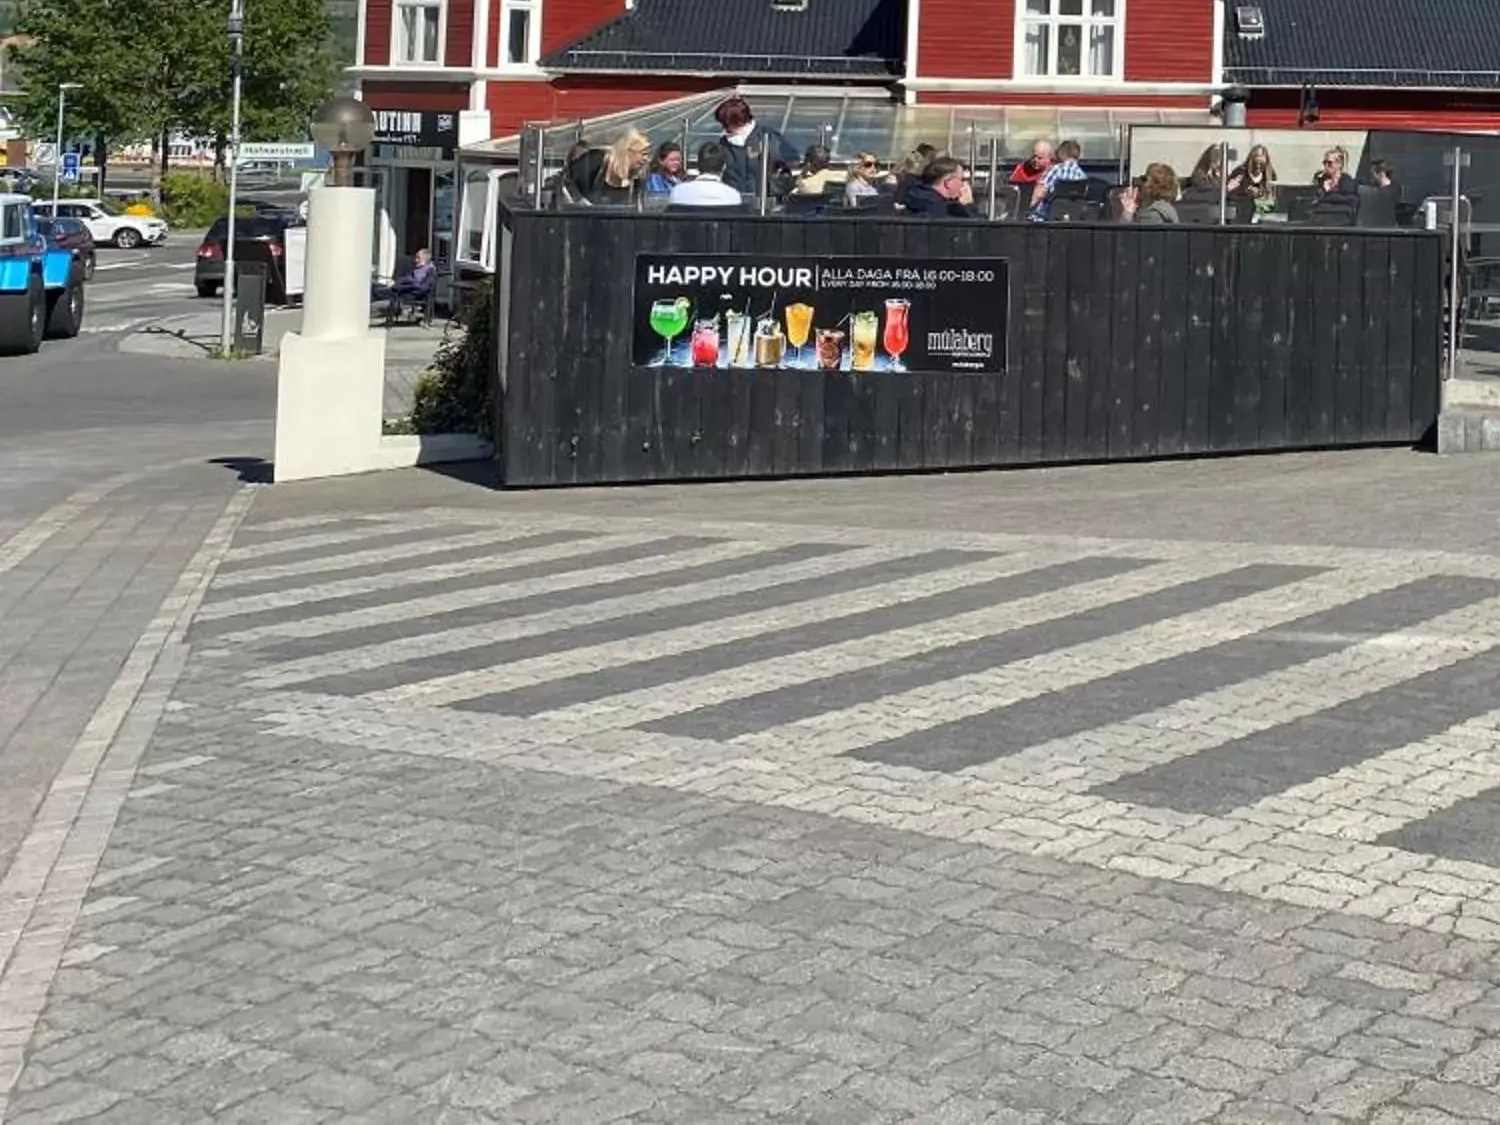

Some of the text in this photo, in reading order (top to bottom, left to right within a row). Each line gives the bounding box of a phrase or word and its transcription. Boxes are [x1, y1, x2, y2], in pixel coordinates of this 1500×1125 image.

[371, 110, 422, 132] AUTINN
[647, 265, 812, 287] HAPPY HOUR
[821, 267, 854, 280] ALLA
[857, 268, 893, 280] DAGA
